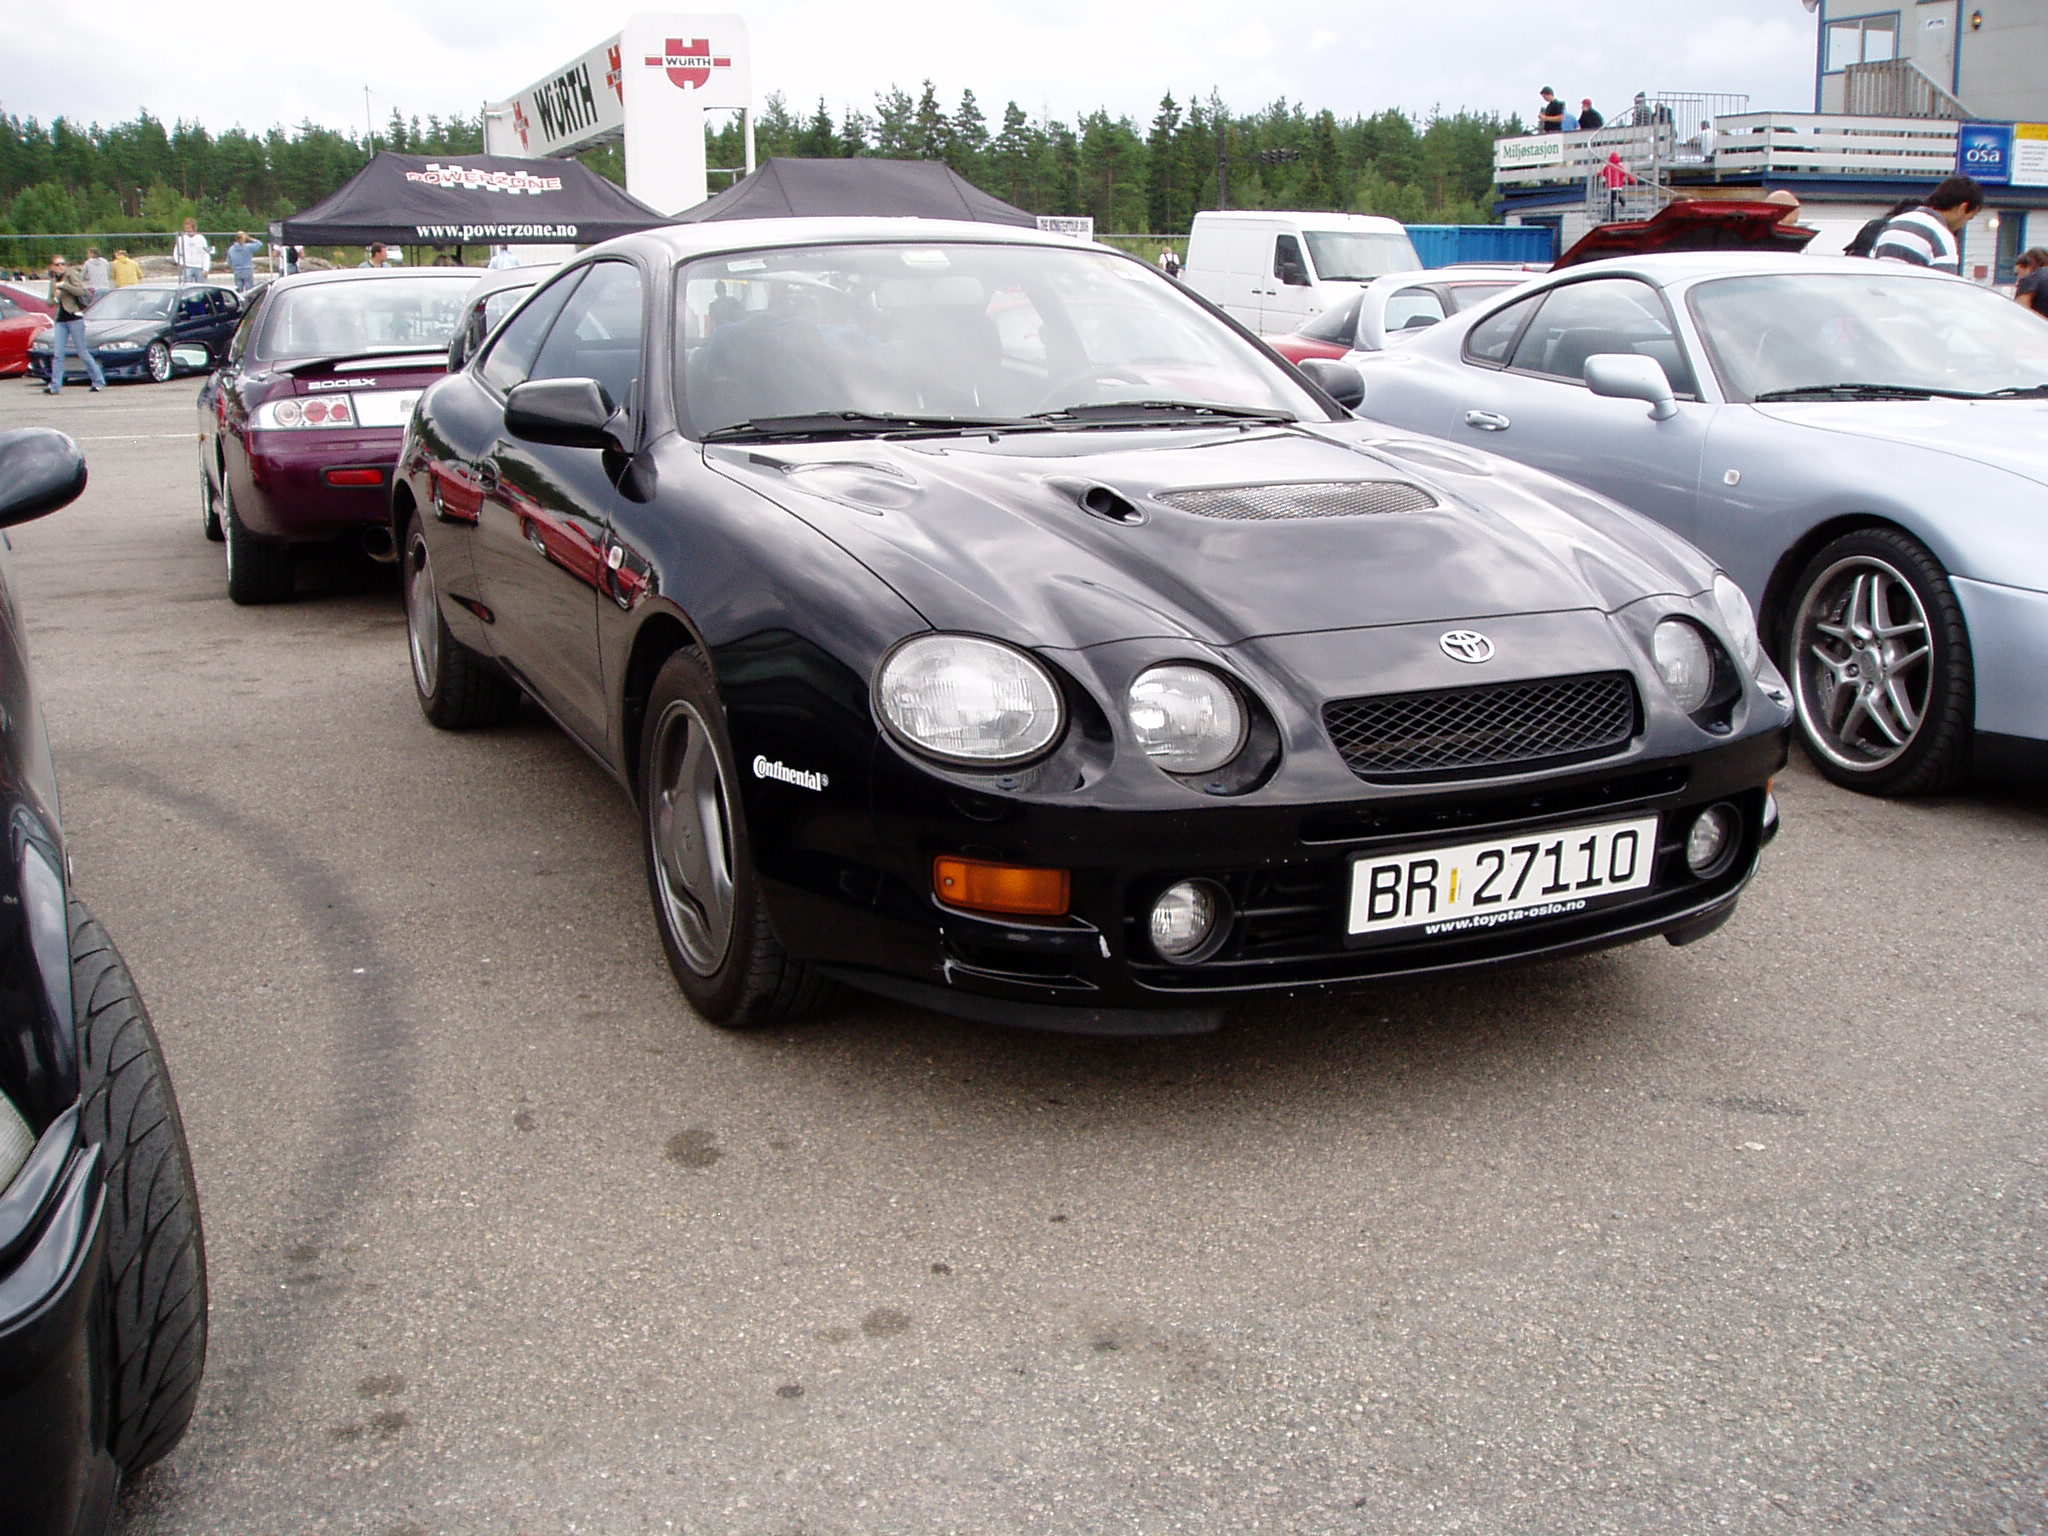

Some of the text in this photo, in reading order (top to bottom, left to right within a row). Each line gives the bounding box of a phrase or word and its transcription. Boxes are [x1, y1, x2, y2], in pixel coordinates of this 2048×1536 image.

[1503, 142, 1559, 160] Miljøstasjon
[406, 170, 562, 191] POWERZONE
[416, 224, 578, 241] www.powerzone.no
[1367, 829, 1640, 922] BR 27110
[1424, 900, 1586, 935] www.toyota-oslo.no
